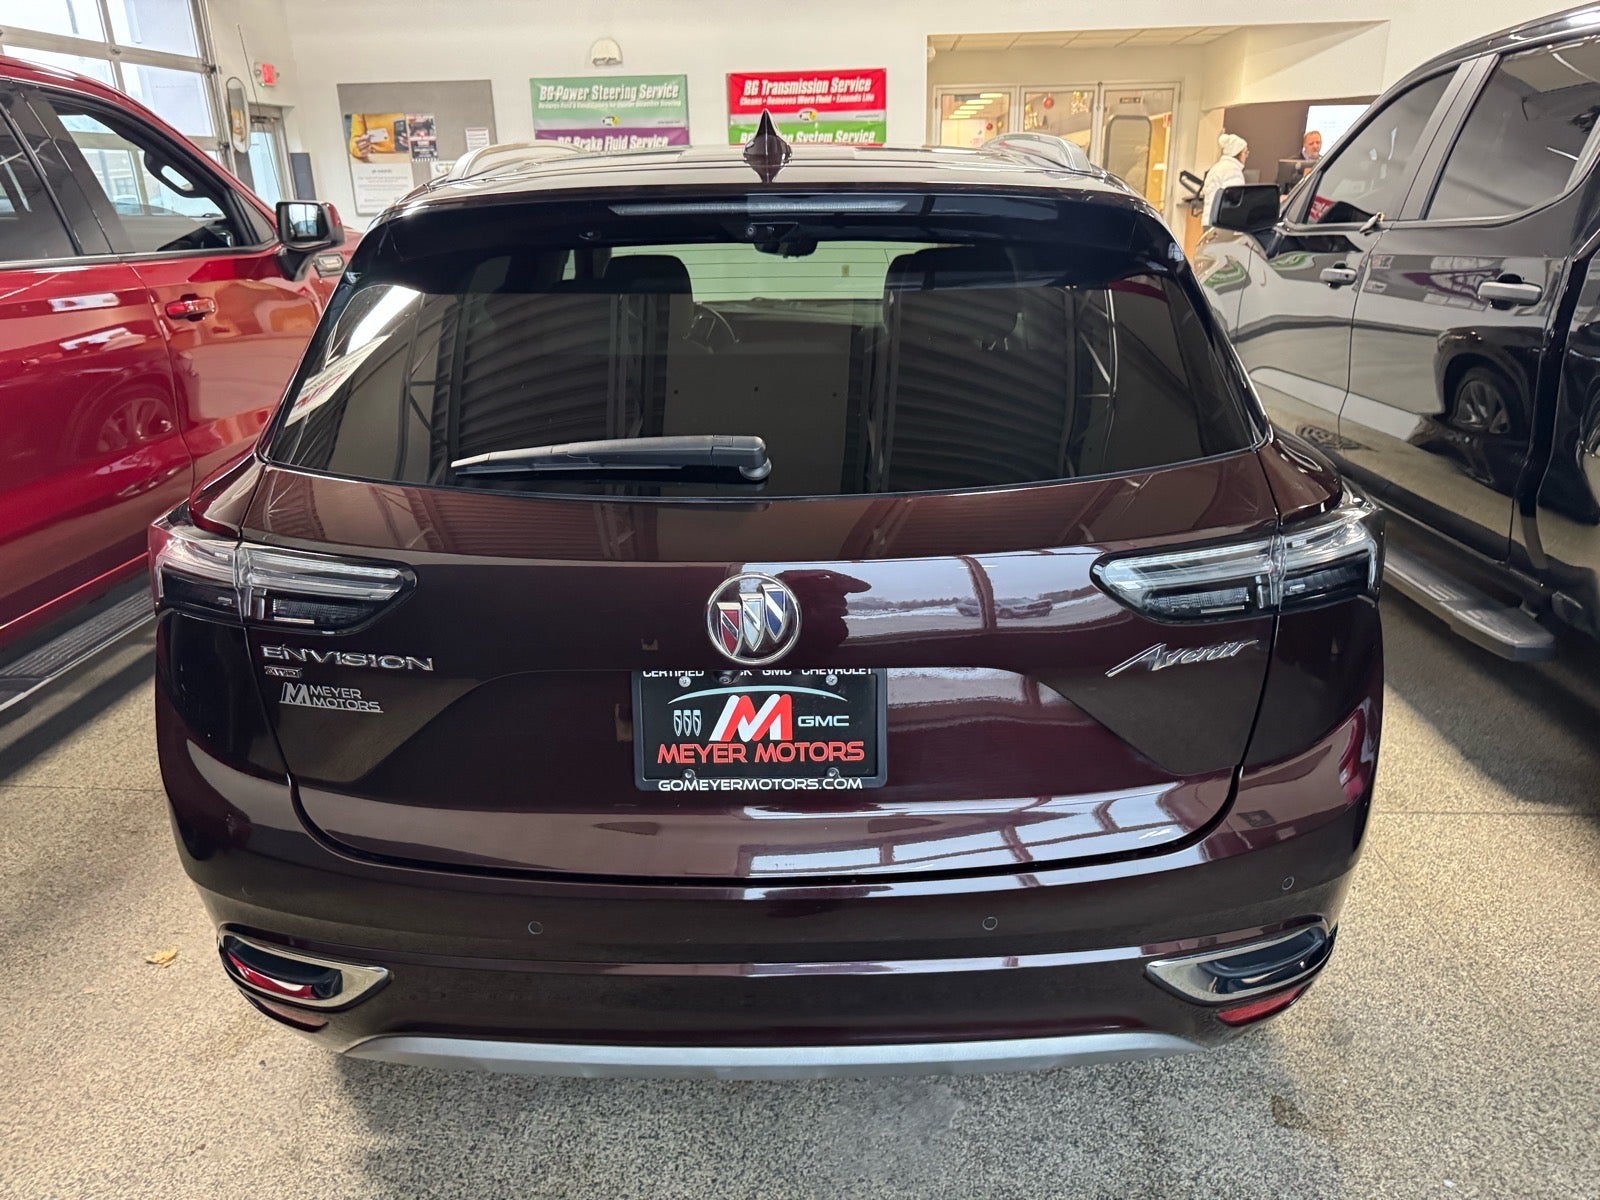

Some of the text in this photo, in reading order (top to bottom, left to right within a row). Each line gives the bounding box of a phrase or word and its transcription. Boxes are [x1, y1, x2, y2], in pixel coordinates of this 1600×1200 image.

[554, 86, 590, 101] Power
[592, 85, 638, 102] Steering
[639, 83, 680, 99] Service
[744, 77, 872, 96] BG Transmission Service
[573, 136, 603, 151] Brake
[604, 136, 629, 151] Fluid
[630, 134, 669, 150] Service
[795, 131, 833, 143] System
[835, 130, 876, 143] Service
[260, 643, 434, 671] ENVISION
[642, 669, 705, 677] CERTIFIED
[309, 686, 362, 700] MEYER
[311, 698, 381, 712] MOTORS
[797, 715, 850, 727] GMC
[657, 741, 865, 764] MEYER MOTORS
[658, 777, 864, 792] GOMEYERMOTORS.COM
